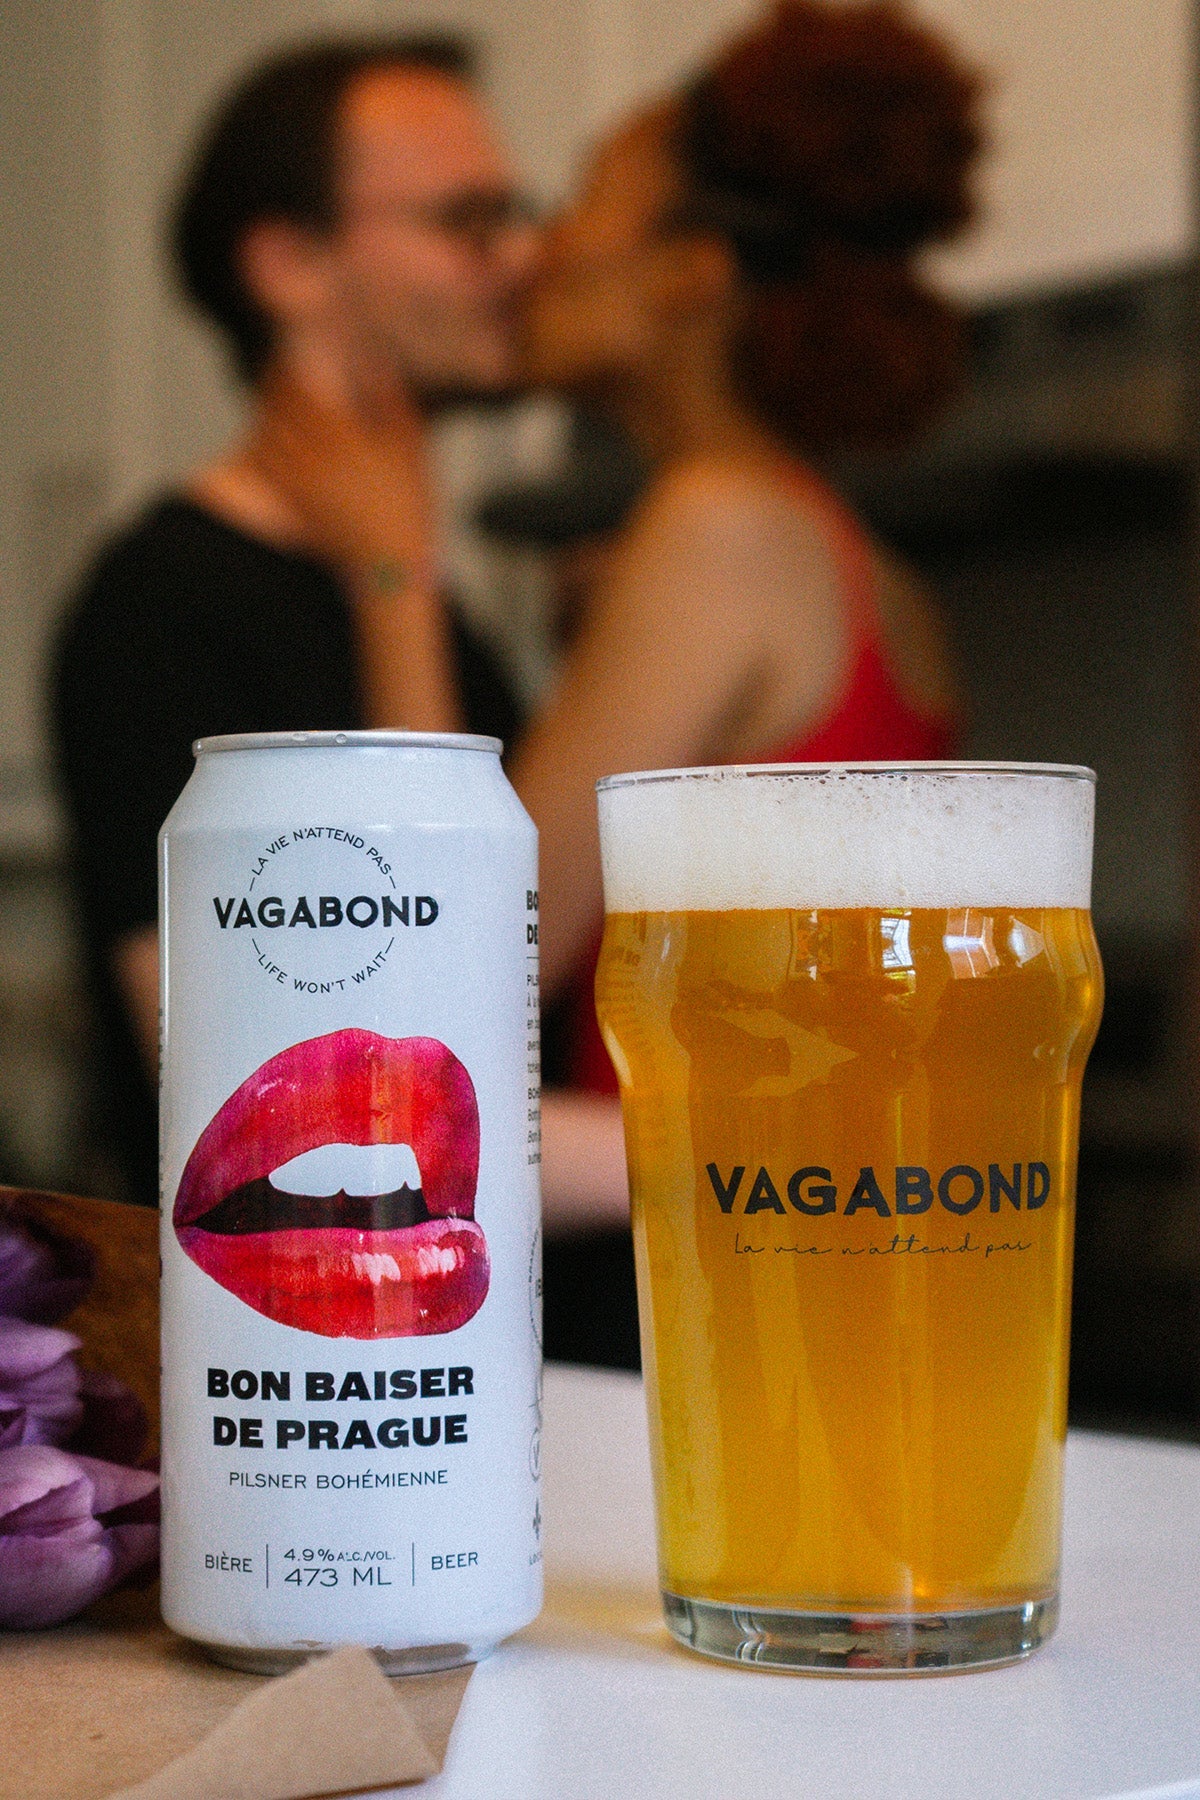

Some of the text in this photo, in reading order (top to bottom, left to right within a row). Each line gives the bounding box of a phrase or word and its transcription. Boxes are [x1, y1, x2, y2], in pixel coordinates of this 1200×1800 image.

[251, 827, 392, 876] LA VIE N'ATTEND PAS
[212, 896, 440, 929] VAGABOND
[258, 952, 388, 994] LIFE WON'T WAIT
[705, 1161, 1051, 1218] VAGABOND
[774, 1243, 832, 1255] vie
[985, 1240, 1032, 1258] pas
[207, 1366, 474, 1401] BON BAISER
[213, 1414, 468, 1450] DE PRAGUE
[229, 1468, 449, 1490] PILSNER BOHÉMIENNE
[205, 1551, 253, 1573] BIÈRE
[284, 1566, 392, 1587] 473 ML
[430, 1551, 479, 1571] BEER
